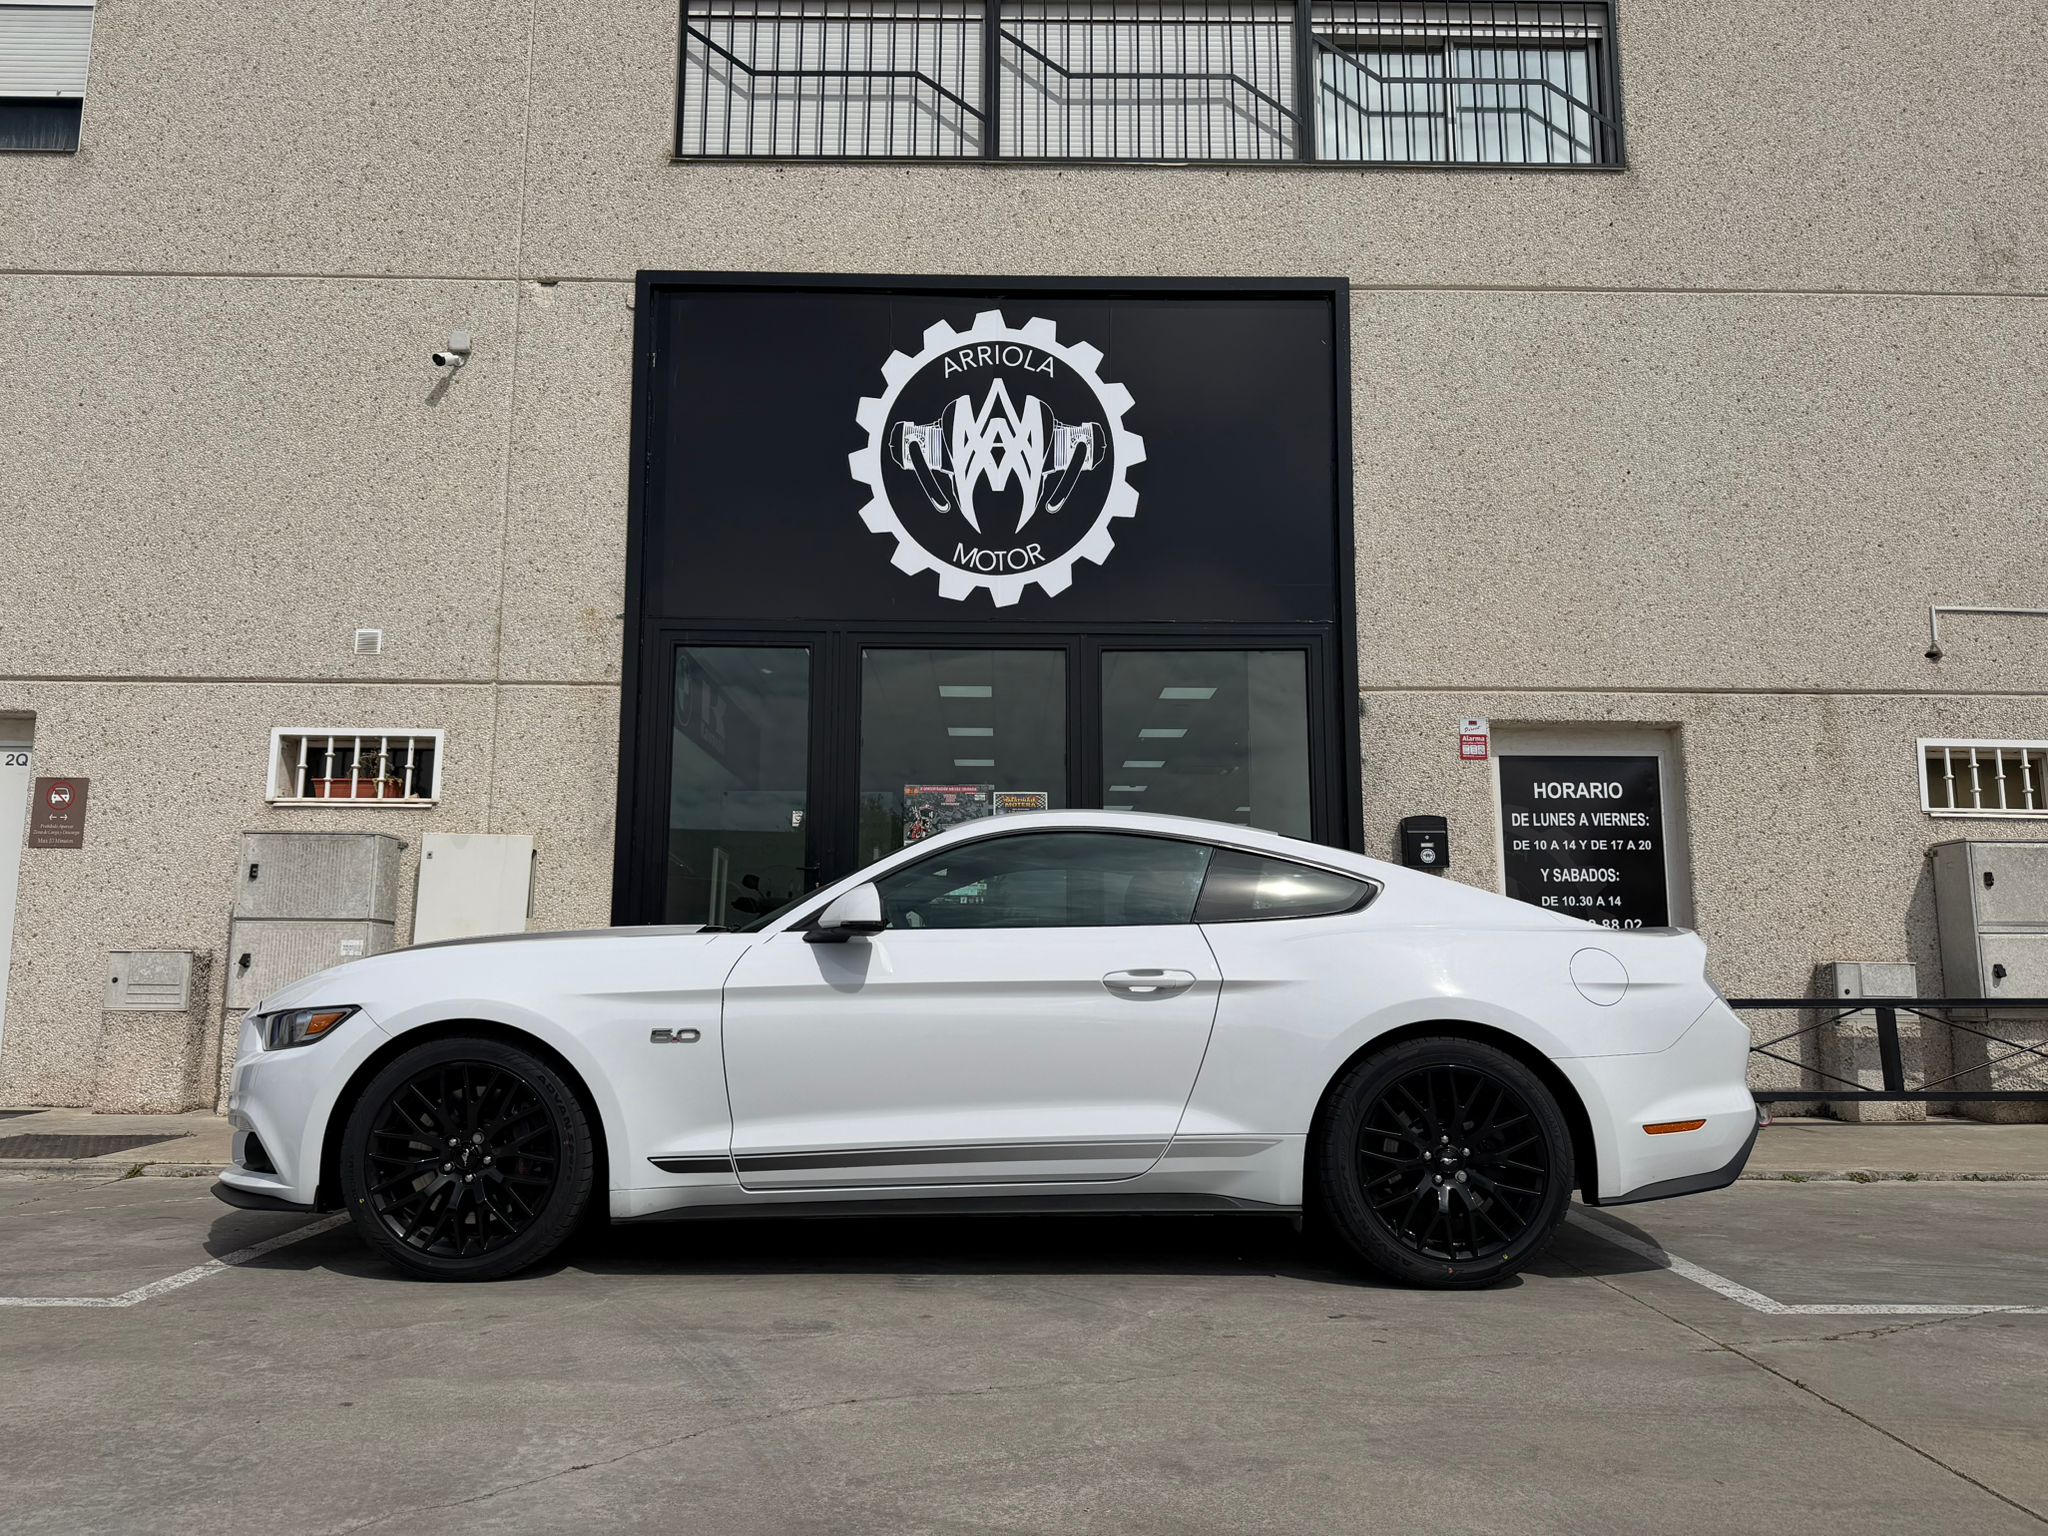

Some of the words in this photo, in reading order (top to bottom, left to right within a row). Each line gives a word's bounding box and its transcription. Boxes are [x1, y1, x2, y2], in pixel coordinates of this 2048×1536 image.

[944, 345, 1054, 378] ARRIOLA
[952, 542, 1046, 571] MOTOR
[5, 753, 29, 766] 2Q
[1533, 782, 1623, 799] HORARIO
[1511, 813, 1530, 827] DE
[1533, 813, 1576, 827] LUNES
[1579, 813, 1589, 827] A
[1591, 813, 1650, 827] VIERNES:
[1513, 840, 1530, 850] DE
[1534, 840, 1547, 850] 10
[1550, 840, 1560, 850] A
[1562, 840, 1576, 850] 14
[1579, 840, 1588, 850] Y
[1591, 840, 1607, 850] DE
[1610, 840, 1623, 850] 17
[1626, 840, 1636, 850] A
[1638, 840, 1652, 850] 20
[1540, 868, 1550, 882] Y
[1553, 868, 1620, 882] SABADOS:
[1541, 896, 1559, 907] DE
[1562, 896, 1593, 907] 10.30
[1596, 896, 1606, 907] A
[1608, 896, 1622, 907] 14
[650, 1028, 701, 1043] 5.0
[537, 1074, 573, 1129] ADVAN
